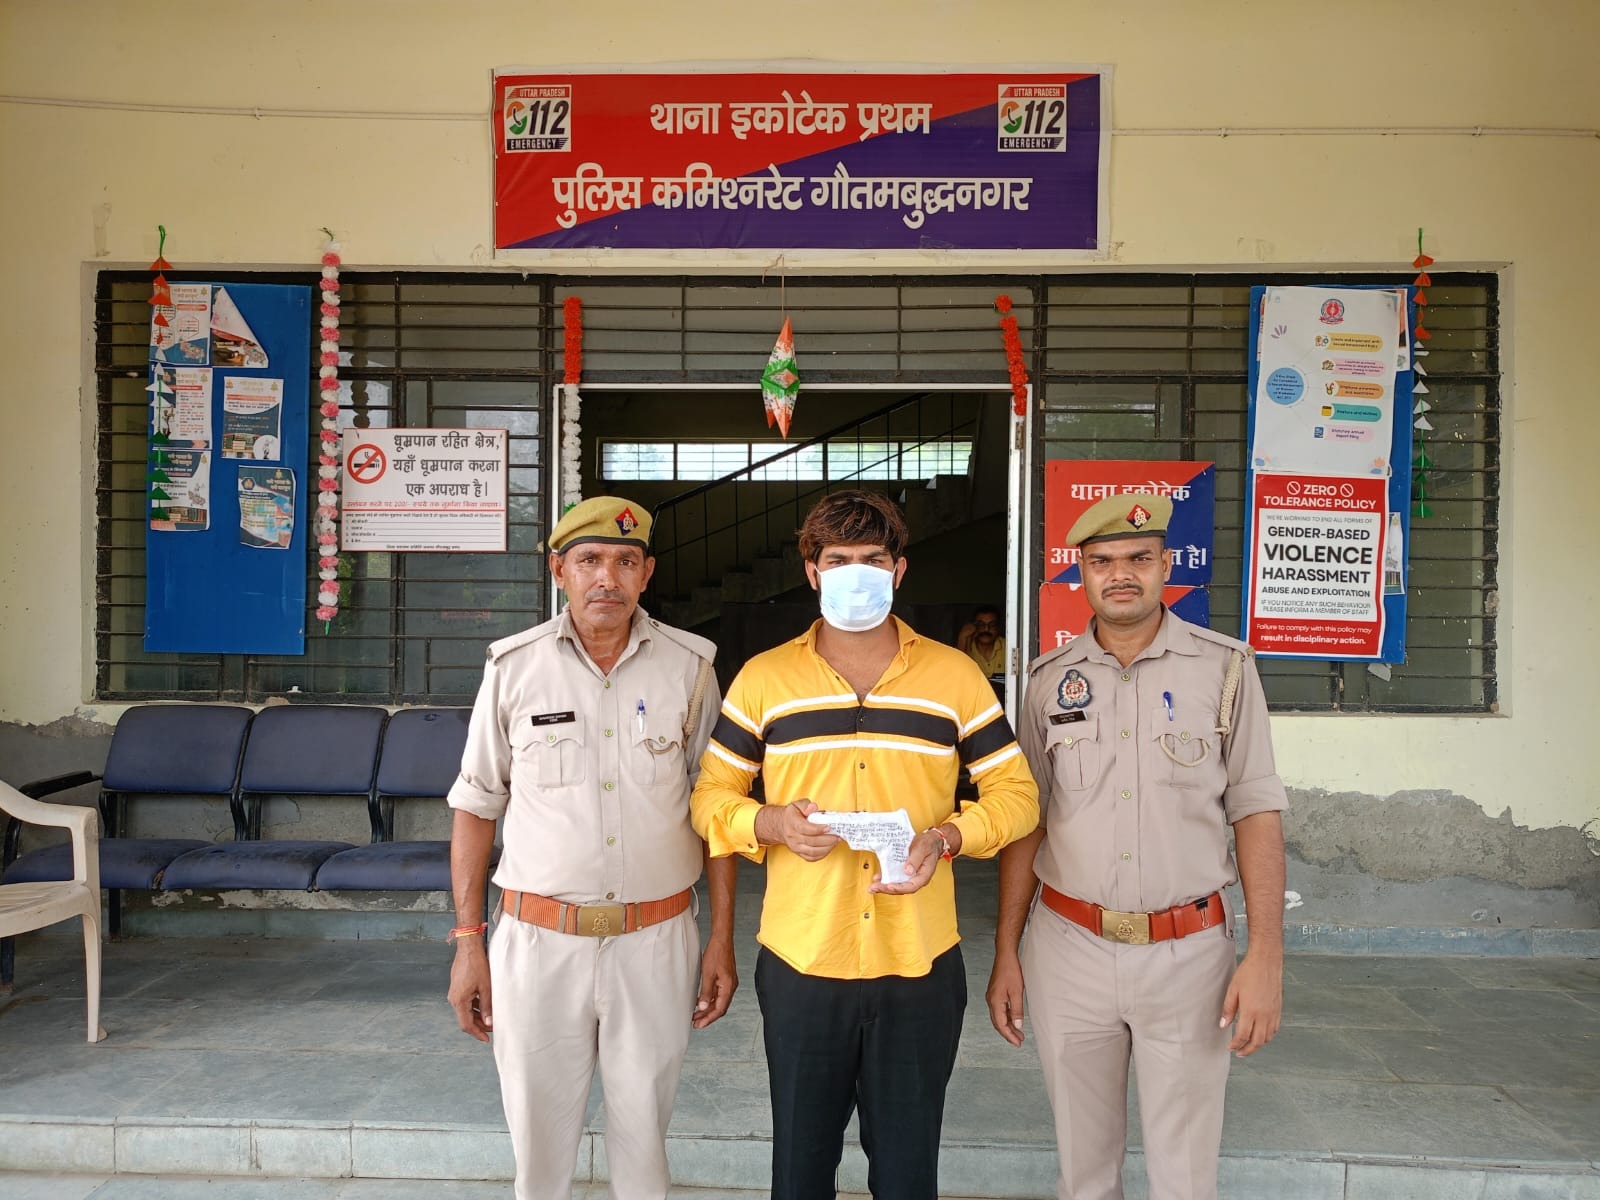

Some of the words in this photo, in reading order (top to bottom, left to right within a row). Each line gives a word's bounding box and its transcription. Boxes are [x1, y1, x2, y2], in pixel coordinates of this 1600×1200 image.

[520, 88, 538, 97] UTTAR
[540, 88, 565, 97] PRADESH
[1014, 87, 1032, 97] UTTAR
[1034, 87, 1060, 97] PRADESH
[529, 100, 569, 135] 112
[650, 103, 722, 134] थाना
[729, 90, 849, 139] इकोटेक
[857, 103, 932, 141] प्रथम
[1024, 100, 1064, 134] 112
[511, 139, 556, 149] EMERGENCY
[1004, 138, 1051, 148] EMERGENCY
[552, 162, 644, 228] पुलिस
[651, 162, 805, 210] कमिश्नरेट
[810, 161, 1033, 229] गौतमबुद्धनगर
[394, 434, 437, 452] धूम्रपान
[441, 431, 470, 448] रहित
[475, 432, 500, 450] क्षेत्र,
[392, 454, 416, 473] यहाँ
[420, 460, 464, 476] धूम्रपान
[468, 459, 501, 472] करना
[405, 483, 425, 497] एक
[429, 483, 470, 496] अपराध
[1071, 484, 1118, 500] थाना
[1303, 484, 1337, 496] ZERO
[1263, 495, 1334, 508] TOLERANCE
[1334, 499, 1376, 509] POLICY
[1268, 526, 1370, 540] GENDER-BASED
[1264, 543, 1373, 565] VIOLENCE
[1262, 567, 1371, 584] HARASSMENT
[1262, 586, 1289, 594] ABUSE
[1291, 587, 1310, 595] AND
[1311, 588, 1371, 597] EXPLOITATION
[1338, 626, 1356, 634] policy
[1260, 634, 1284, 642] result
[1293, 635, 1338, 645] disciplinary
[1339, 637, 1366, 645] action.
